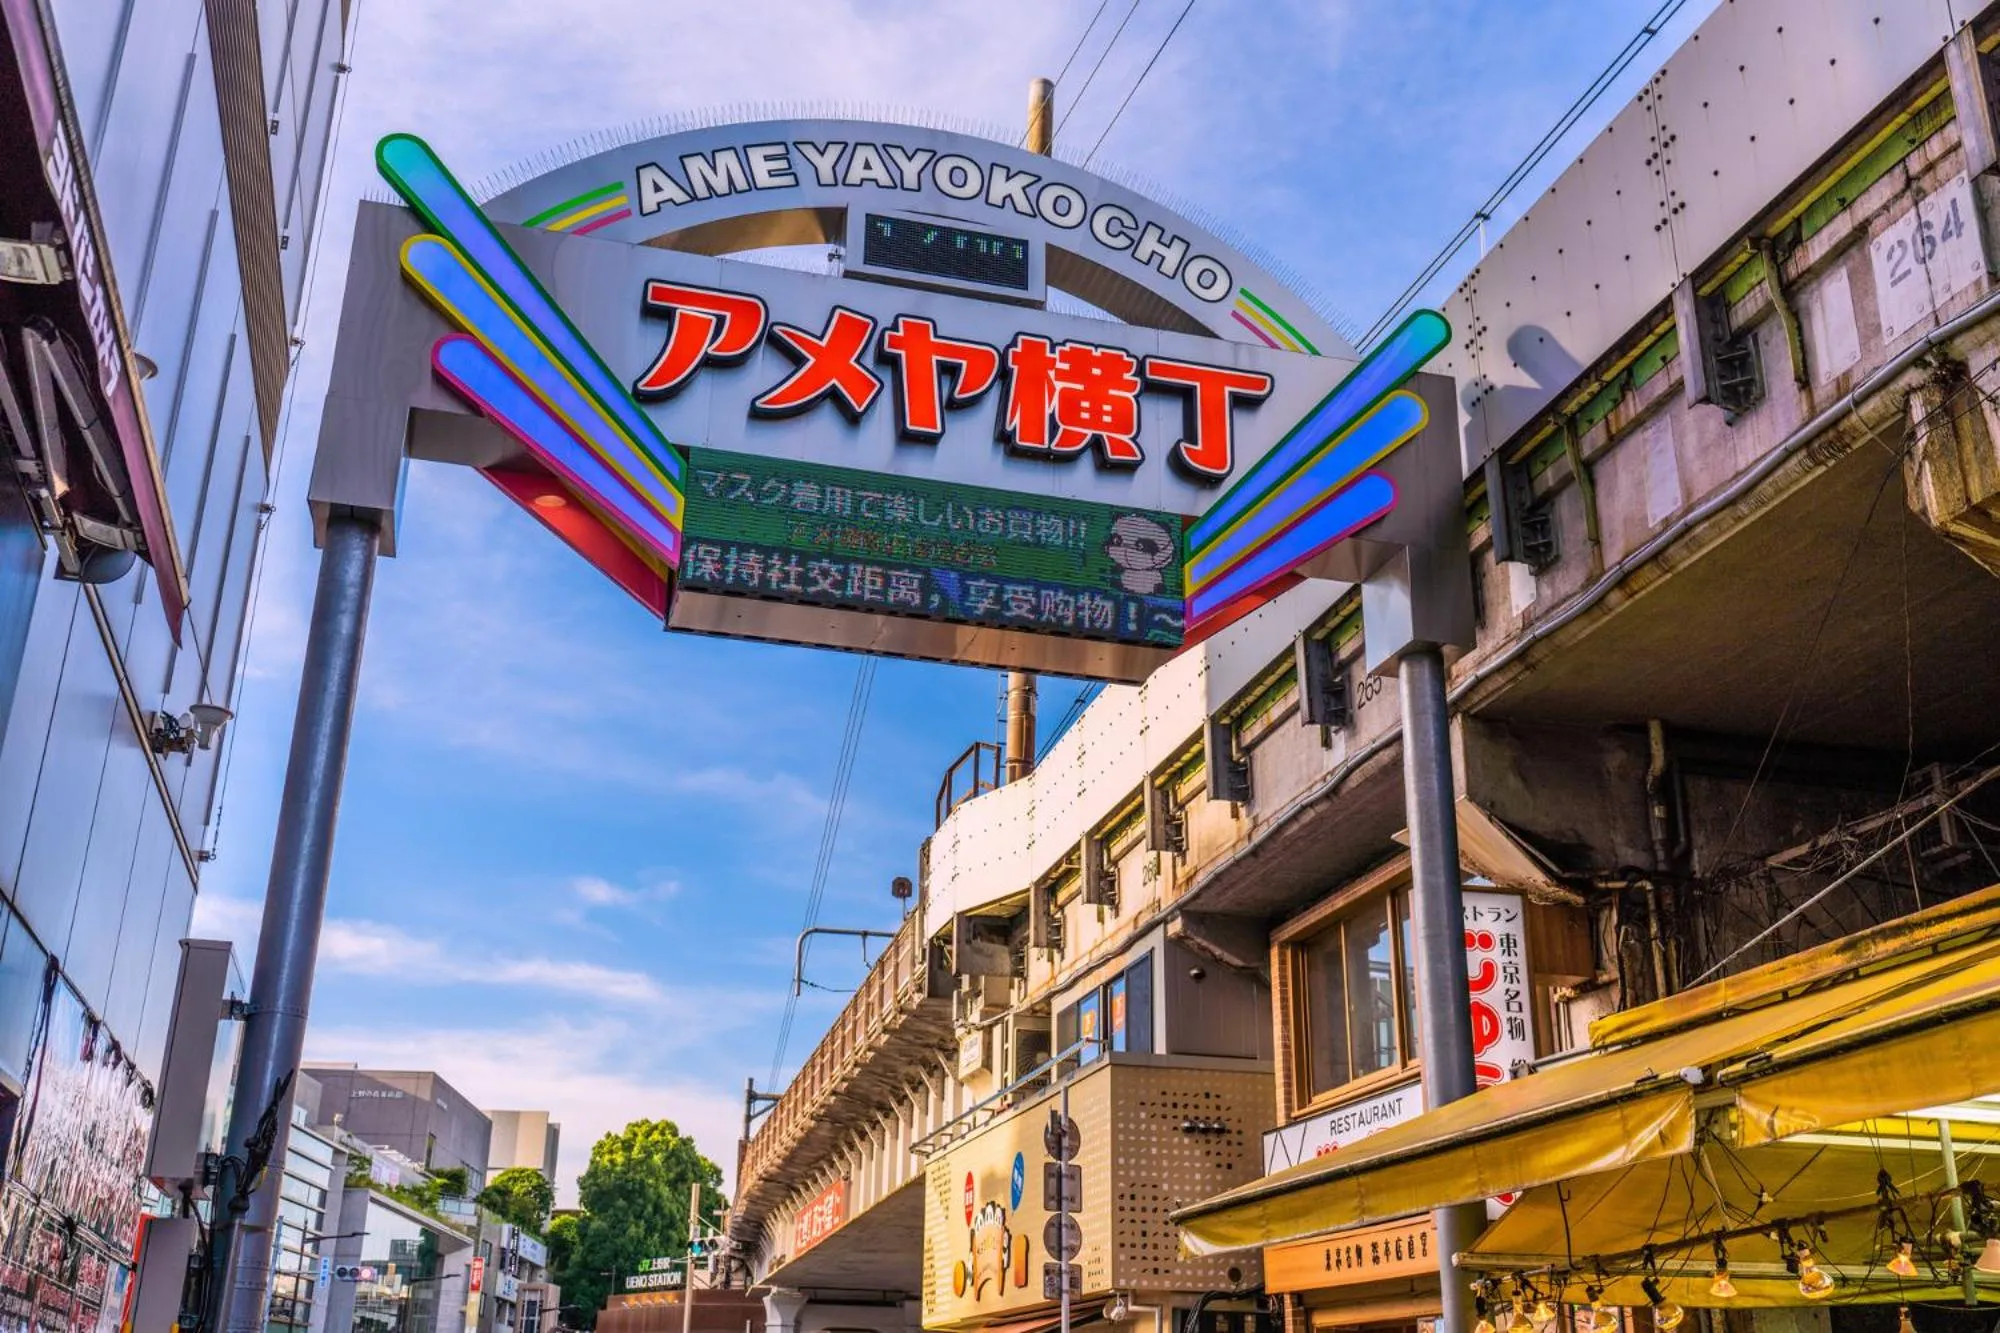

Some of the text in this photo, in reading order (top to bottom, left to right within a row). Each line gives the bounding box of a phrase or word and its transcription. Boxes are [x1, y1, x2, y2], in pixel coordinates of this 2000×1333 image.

[635, 139, 1234, 304] AMEYAYOKOCHO
[1886, 197, 1965, 288] 264
[633, 279, 1275, 482] アメヤ横丁
[1357, 672, 1382, 710] 265
[1499, 932, 1527, 1042] 東京名物
[1330, 1097, 1403, 1137] RESTAURANT
[626, 1271, 682, 1289] UENO STATION
